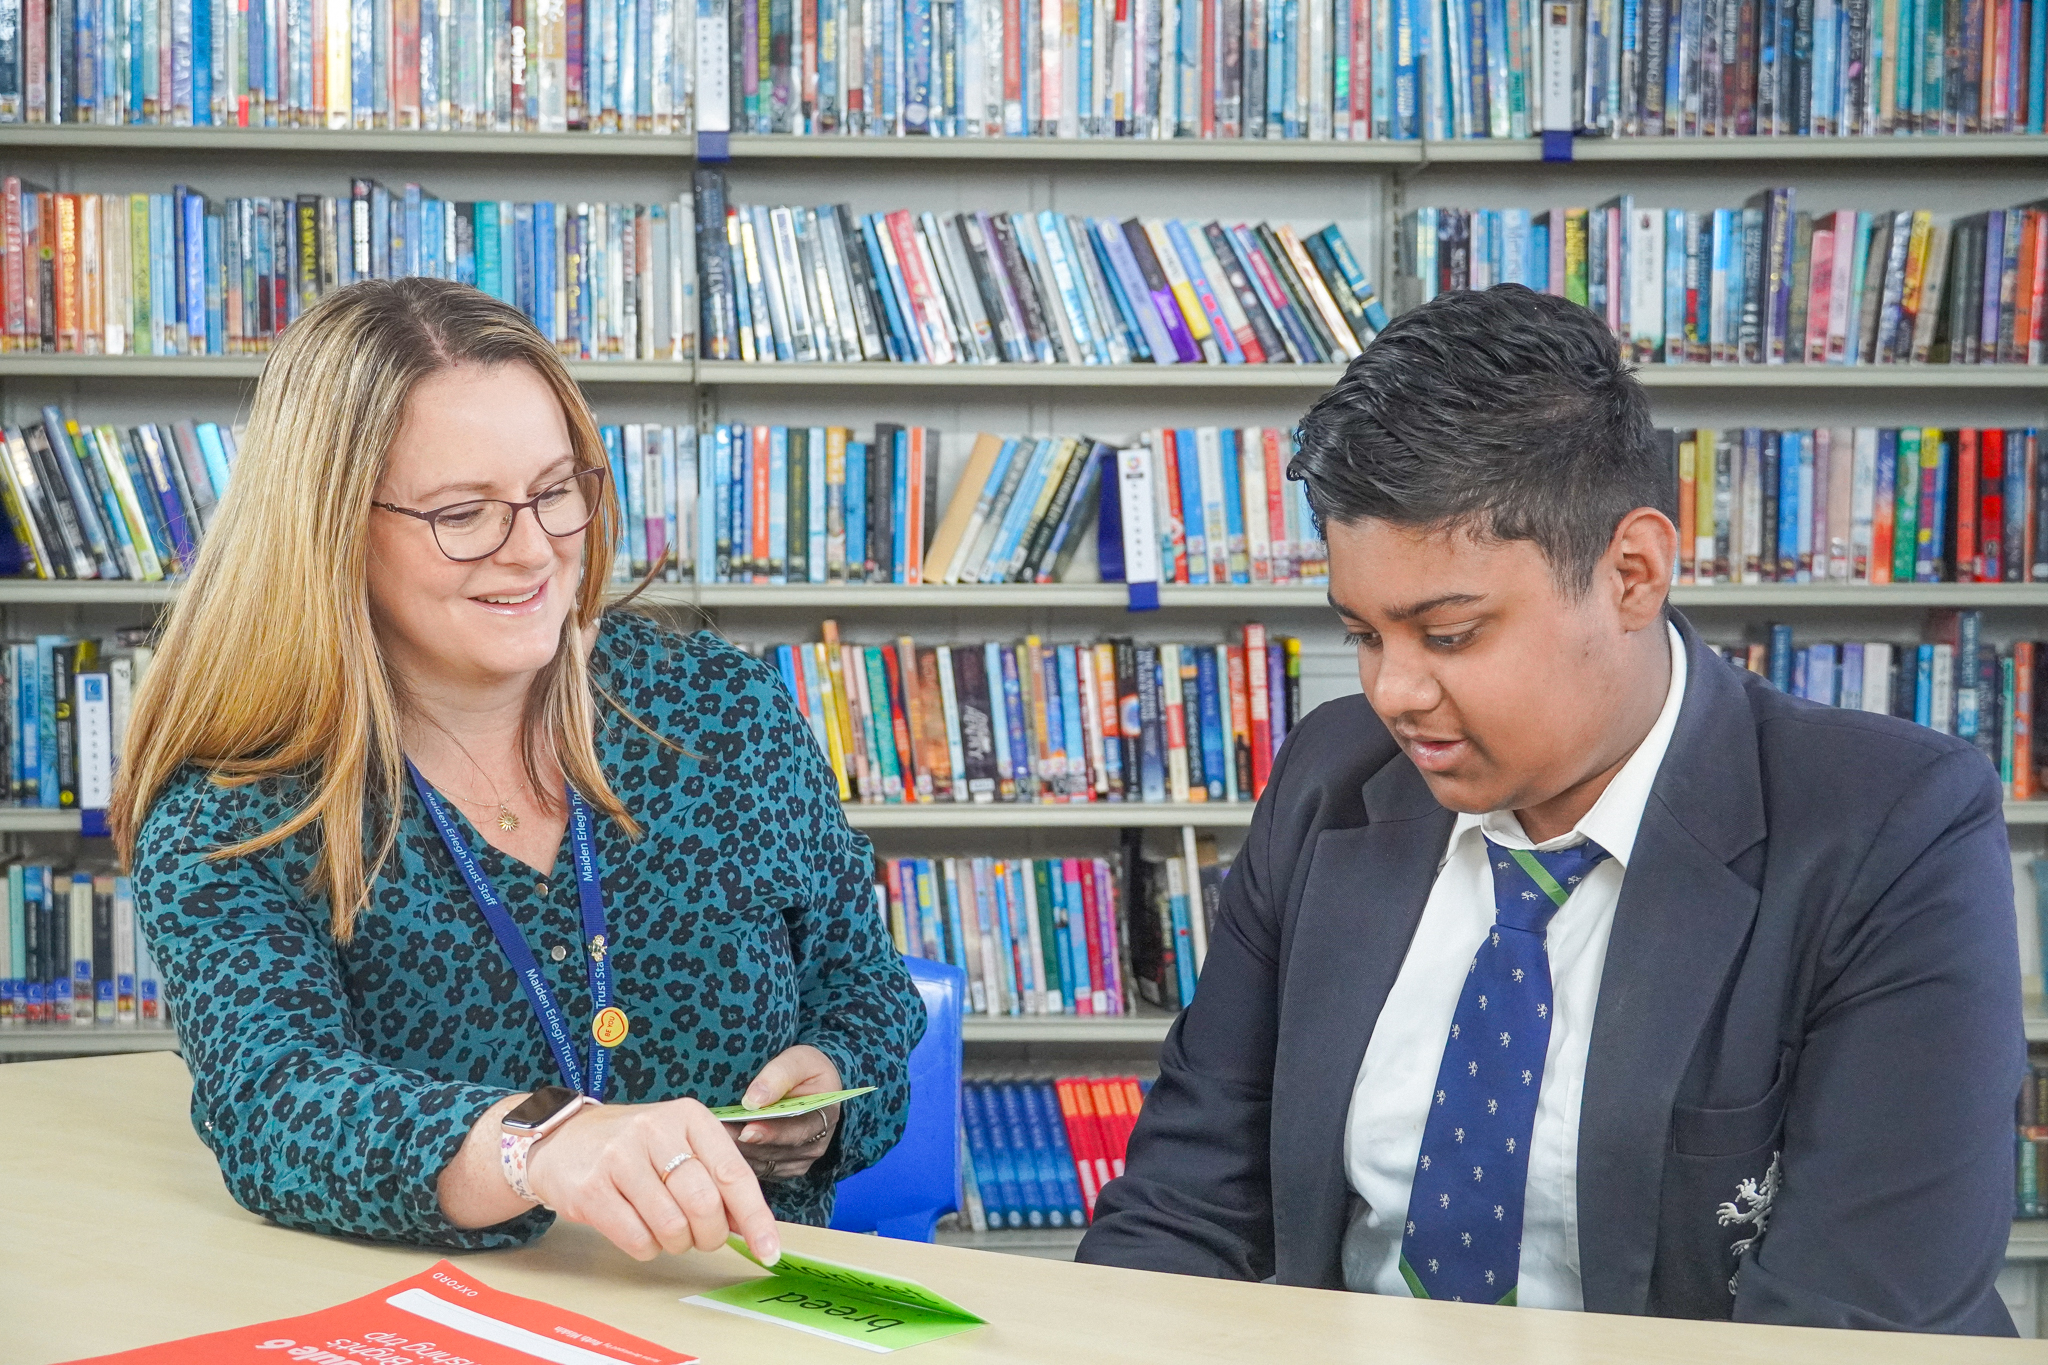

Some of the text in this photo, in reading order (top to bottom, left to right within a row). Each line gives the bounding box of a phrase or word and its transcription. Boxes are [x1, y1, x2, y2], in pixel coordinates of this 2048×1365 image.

[301, 207, 317, 283] SAWKILL
[574, 808, 587, 841] Erlegh
[425, 792, 498, 906] Maiden Erlegh Trust Staff
[580, 843, 594, 882] Maiden
[595, 959, 606, 979] Sta
[595, 980, 606, 1009] Trust
[525, 968, 550, 1009] Maiden
[546, 1008, 566, 1045] Erlegh
[561, 1042, 577, 1072] Trust
[604, 1016, 616, 1038] BE YOU
[593, 1049, 605, 1092] Maiden
[432, 1272, 479, 1298] OXFORD
[757, 1291, 905, 1333] breed
[255, 1338, 297, 1350] 6
[364, 1332, 408, 1347] trip
[580, 1334, 604, 1346] Ruth
